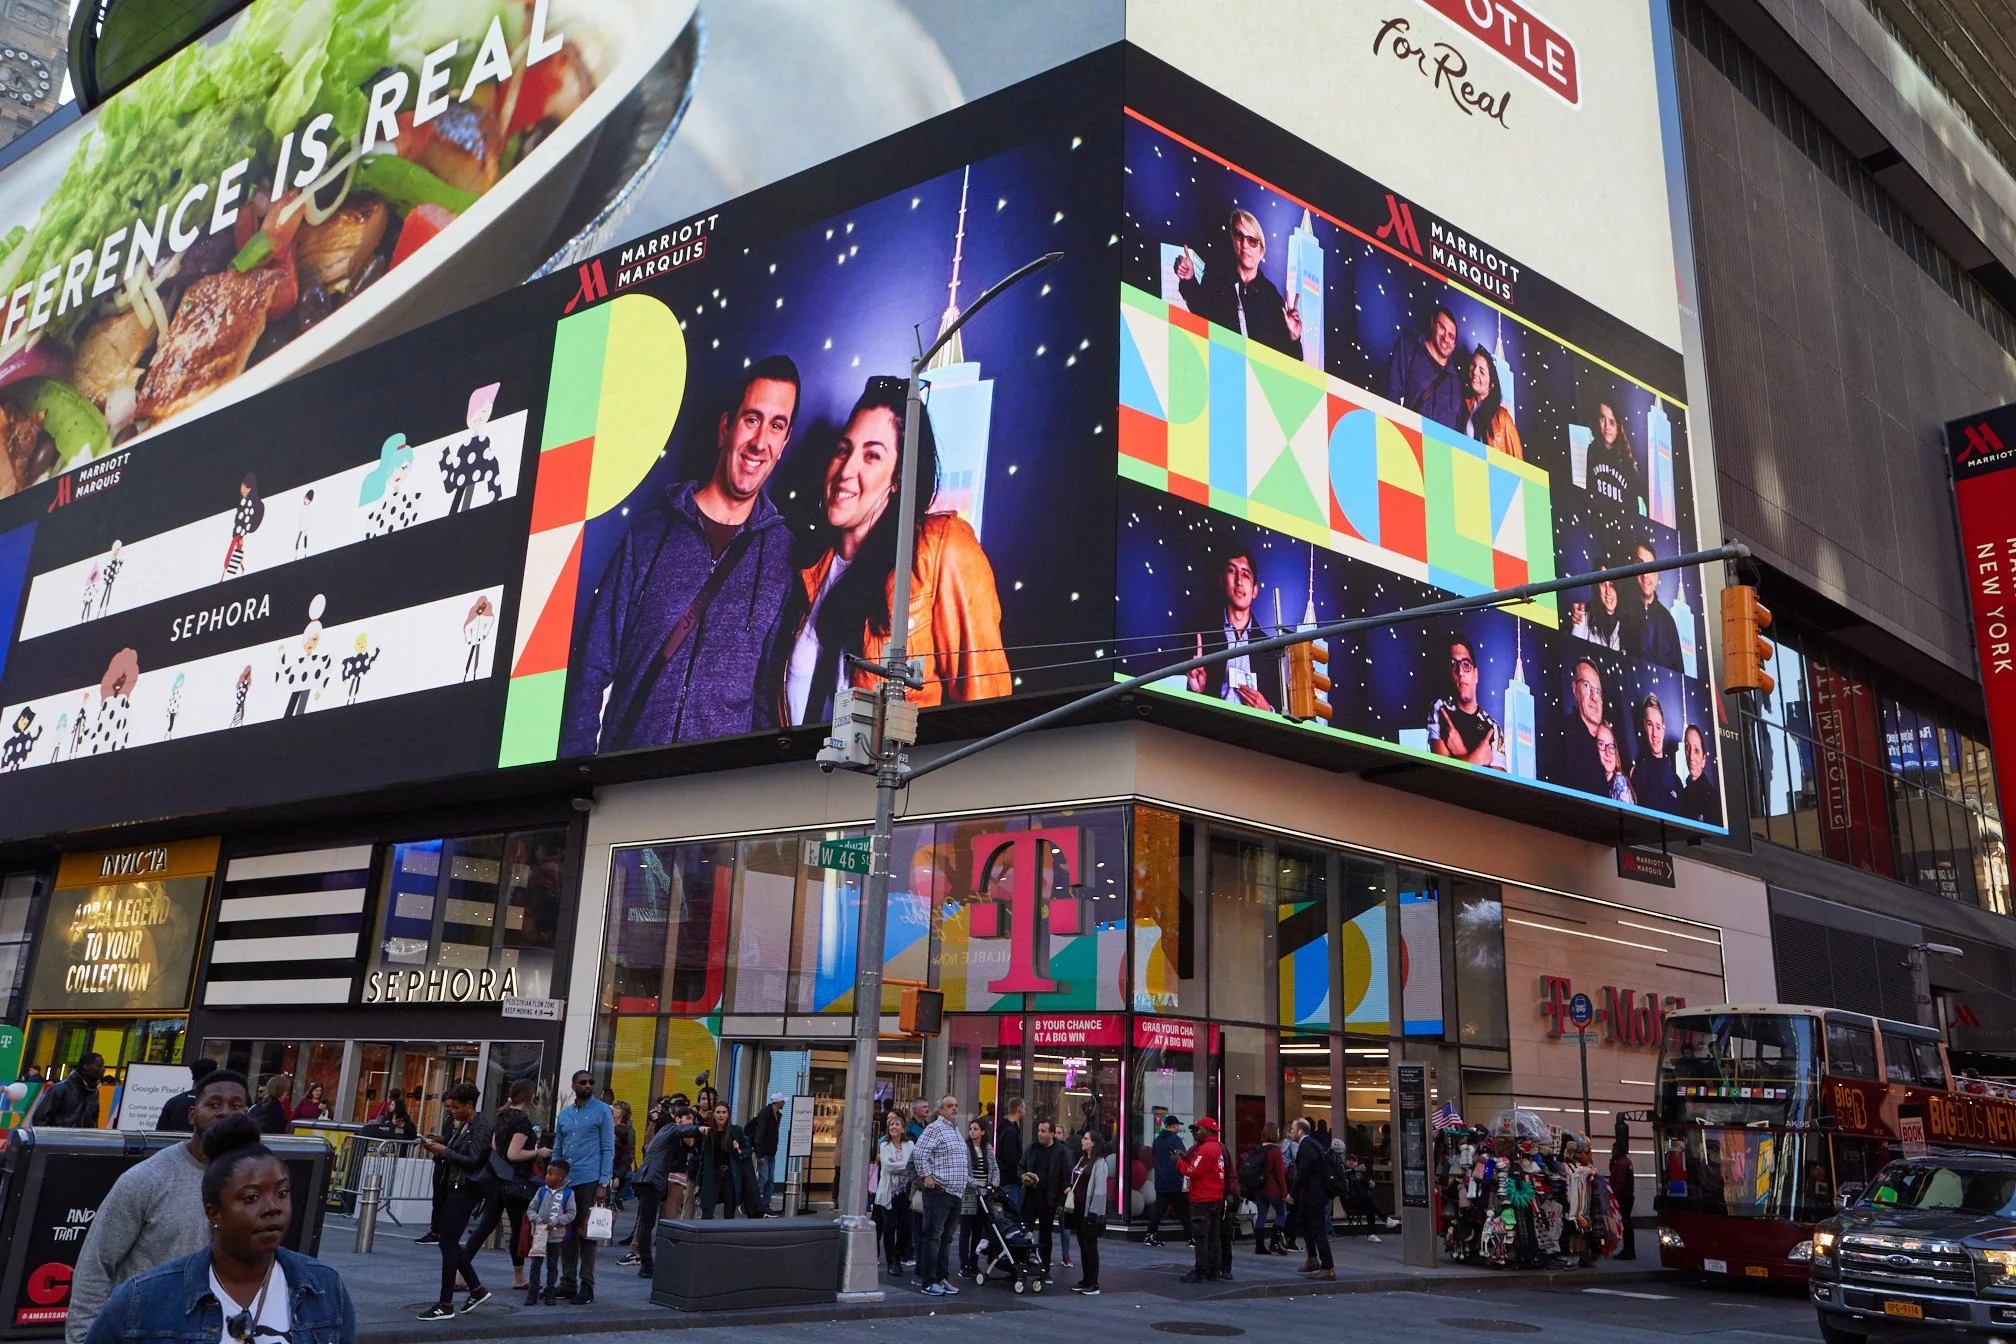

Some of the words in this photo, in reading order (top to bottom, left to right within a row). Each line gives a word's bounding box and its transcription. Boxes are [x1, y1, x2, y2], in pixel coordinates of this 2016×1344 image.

[1434, 42, 1511, 129] Real
[0, 159, 249, 348] FERENCE
[272, 113, 333, 202] IS
[362, 0, 564, 155] REAL
[621, 213, 719, 266] MARRIOTT
[1431, 221, 1520, 282] MARRIOTT
[618, 241, 704, 288] MARQUIS
[1432, 244, 1511, 300] MARQUIS
[79, 452, 131, 482] MARRIOTT
[75, 471, 121, 498] MARQUIS
[1597, 479, 1623, 503] SEOUL
[1977, 543, 2002, 595] NEW
[170, 593, 270, 642] SEPHORA
[1987, 606, 2013, 674] YORK
[100, 848, 168, 878] INVICTA
[822, 847, 834, 866] W
[840, 850, 855, 870] 46
[861, 854, 870, 866] St
[1636, 855, 1664, 868] MARRIOTT
[1637, 864, 1662, 876] MARQUIS
[114, 895, 171, 928] LEGEND
[970, 826, 1083, 993] T
[84, 931, 103, 961] TO
[105, 930, 143, 961] YOUR
[65, 962, 151, 993] COLLECTION
[367, 967, 518, 1004] SEPHORA
[1034, 1032, 1044, 1042] AT
[1045, 1032, 1051, 1042] A
[1053, 1032, 1067, 1042] BIG
[1068, 1032, 1085, 1042] WIN
[1042, 1020, 1066, 1030] YOUR
[1067, 1019, 1102, 1030] CHANCE
[1142, 1021, 1161, 1033] GRAB
[1161, 1024, 1179, 1035] YOUR
[1154, 1036, 1163, 1045] AT
[1164, 1036, 1169, 1046] A
[1169, 1037, 1181, 1047] BIG
[1181, 1038, 1194, 1048] WIN
[131, 1084, 160, 1094] Google
[161, 1085, 180, 1094] Pixel
[1834, 1086, 1852, 1108] BIG
[1837, 1108, 1855, 1129] BUS
[1902, 1125, 1924, 1142] BOOK
[1985, 1104, 2016, 1142] NEW
[67, 1208, 97, 1223] AND
[52, 1226, 86, 1241] THAT
